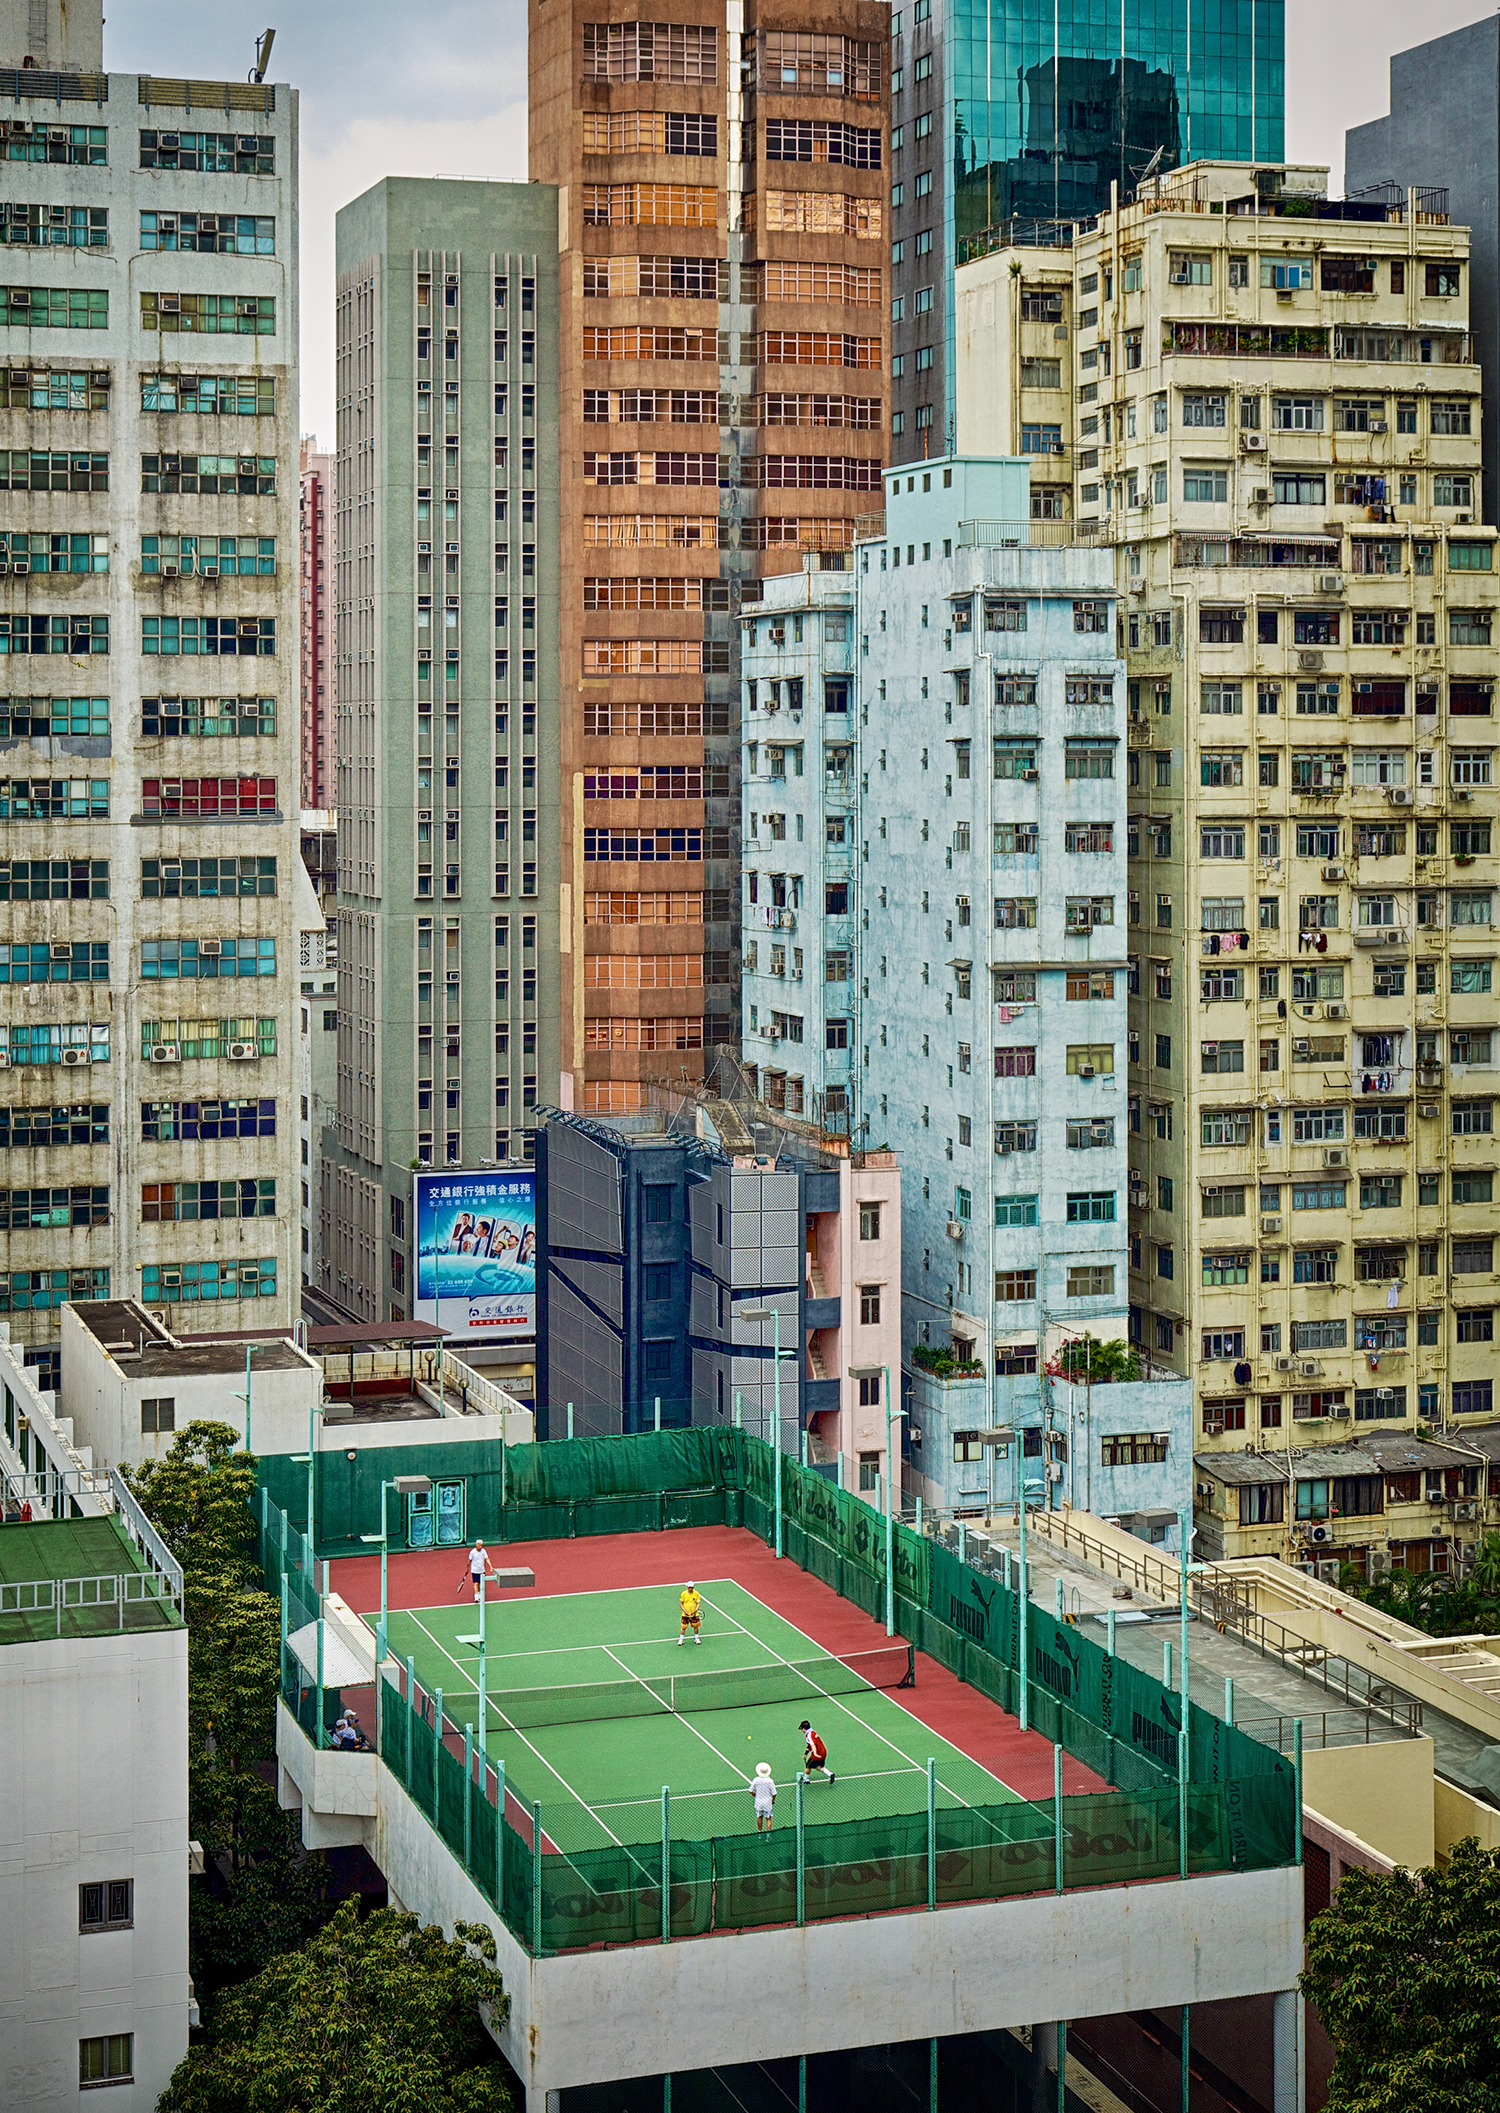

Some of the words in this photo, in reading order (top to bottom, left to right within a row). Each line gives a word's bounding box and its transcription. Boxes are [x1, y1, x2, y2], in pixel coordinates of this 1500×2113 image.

[429, 1183, 531, 1199] 交通銀行強積金服務
[484, 1304, 525, 1315] 交通銀行
[806, 1489, 846, 1536] lotto
[873, 1532, 917, 1580] lotto
[951, 1593, 985, 1642] PUMA
[1011, 1594, 1018, 1615] ON
[1036, 1646, 1071, 1699] PUMA
[1102, 1677, 1108, 1689] IT
[1132, 1711, 1177, 1769] PUMA
[1213, 1718, 1220, 1743] ON
